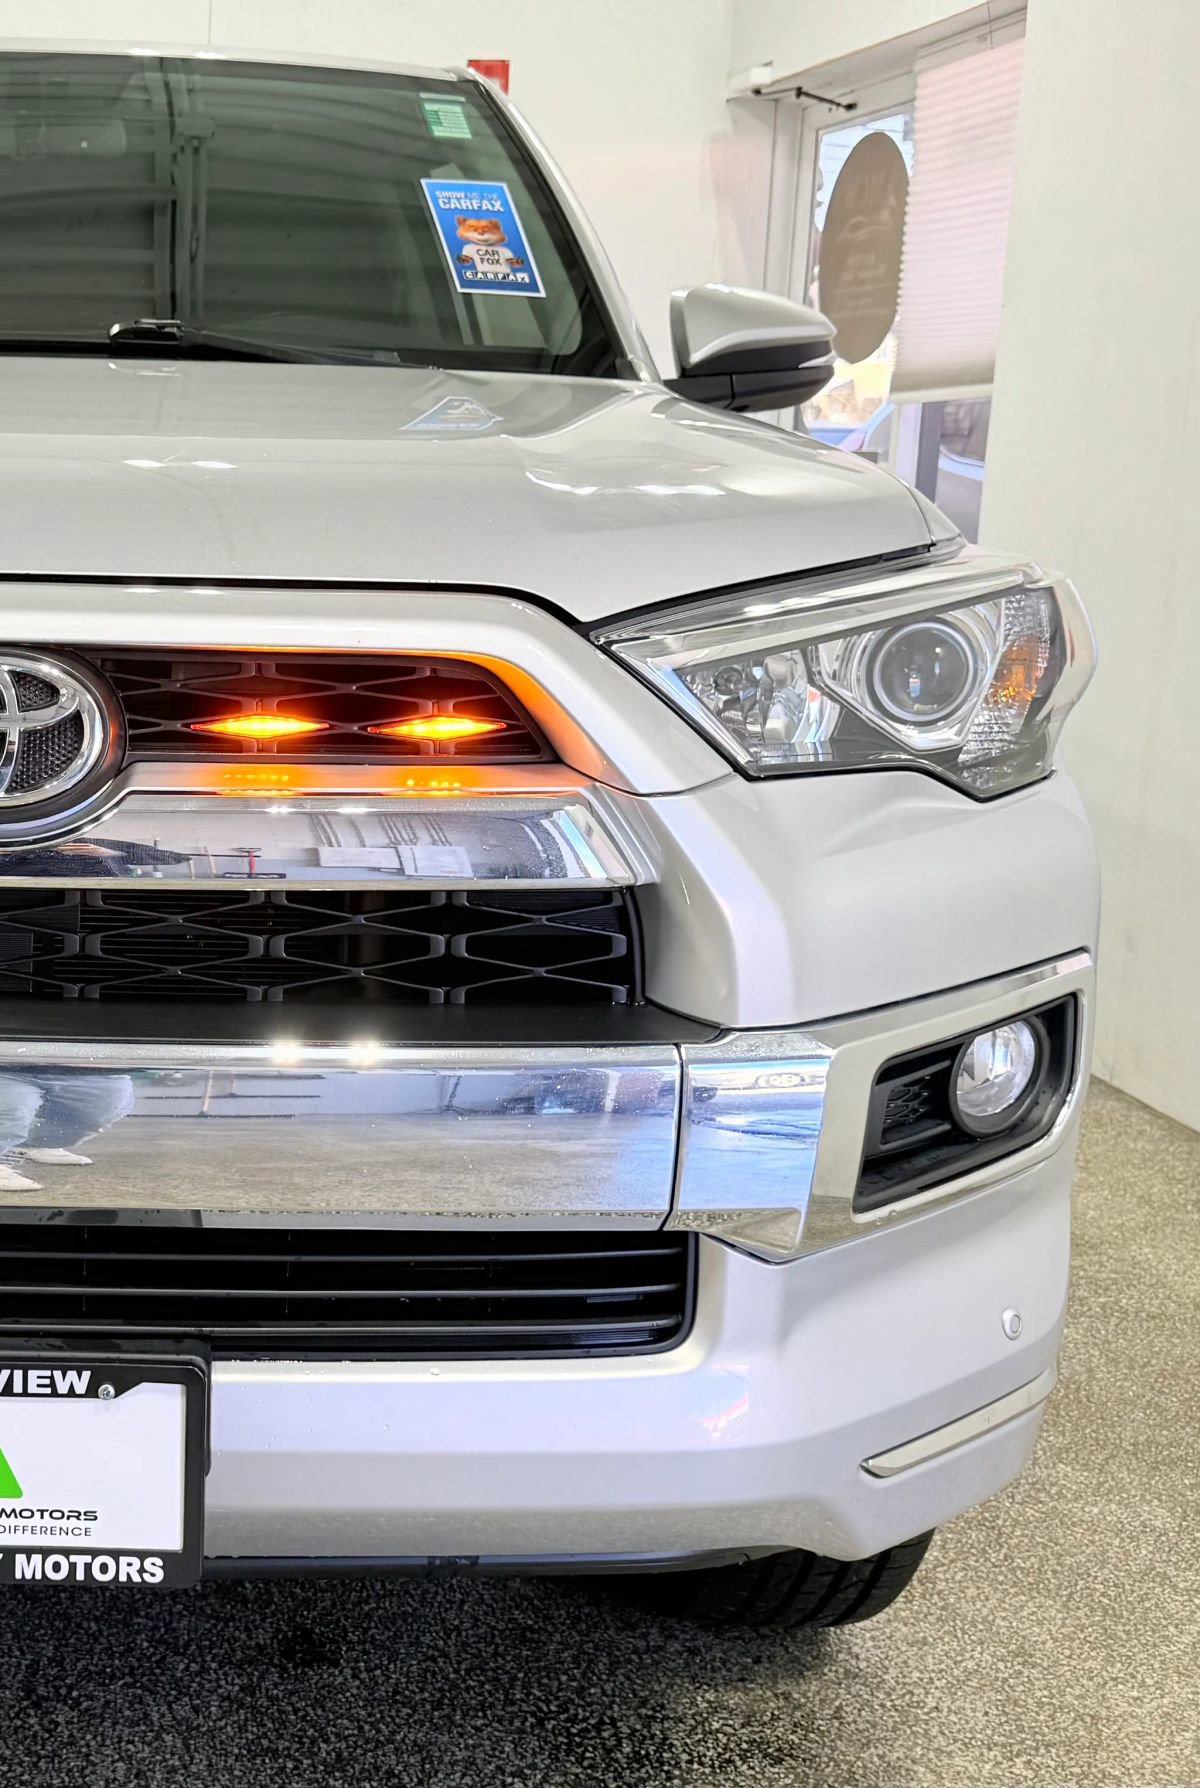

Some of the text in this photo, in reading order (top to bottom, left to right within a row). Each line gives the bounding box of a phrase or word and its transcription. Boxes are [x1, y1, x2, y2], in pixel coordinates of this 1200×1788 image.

[435, 191, 465, 200] SHOW
[438, 199, 504, 212] CARFAX
[476, 248, 499, 258] CAR
[480, 257, 502, 266] FOX
[463, 270, 530, 283] CARFAX
[14, 1554, 165, 1583] MOTORS
